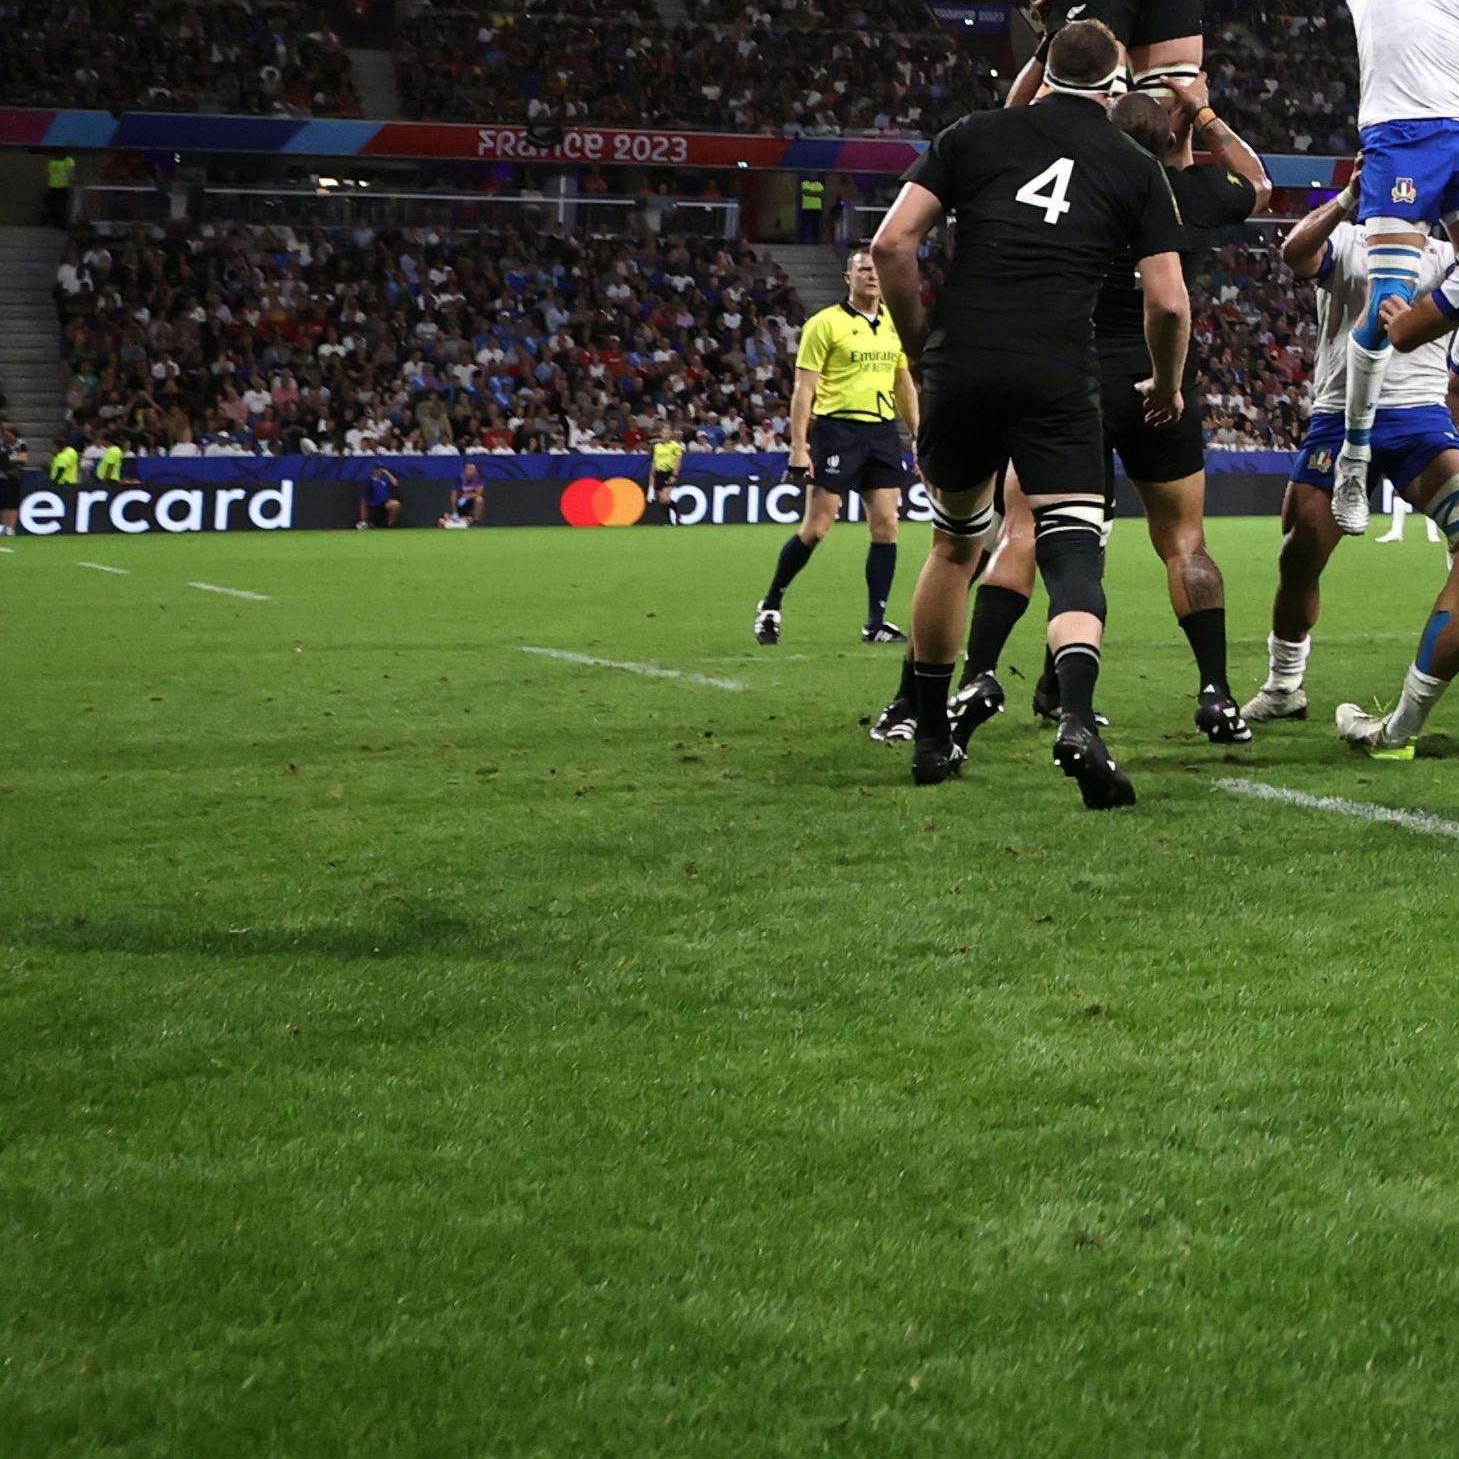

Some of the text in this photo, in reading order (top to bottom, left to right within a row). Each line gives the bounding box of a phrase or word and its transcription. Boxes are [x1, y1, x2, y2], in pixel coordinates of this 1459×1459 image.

[613, 134, 689, 163] 2023
[1015, 157, 1075, 225] 4
[851, 349, 898, 363] Emirate
[19, 479, 293, 535] ercard
